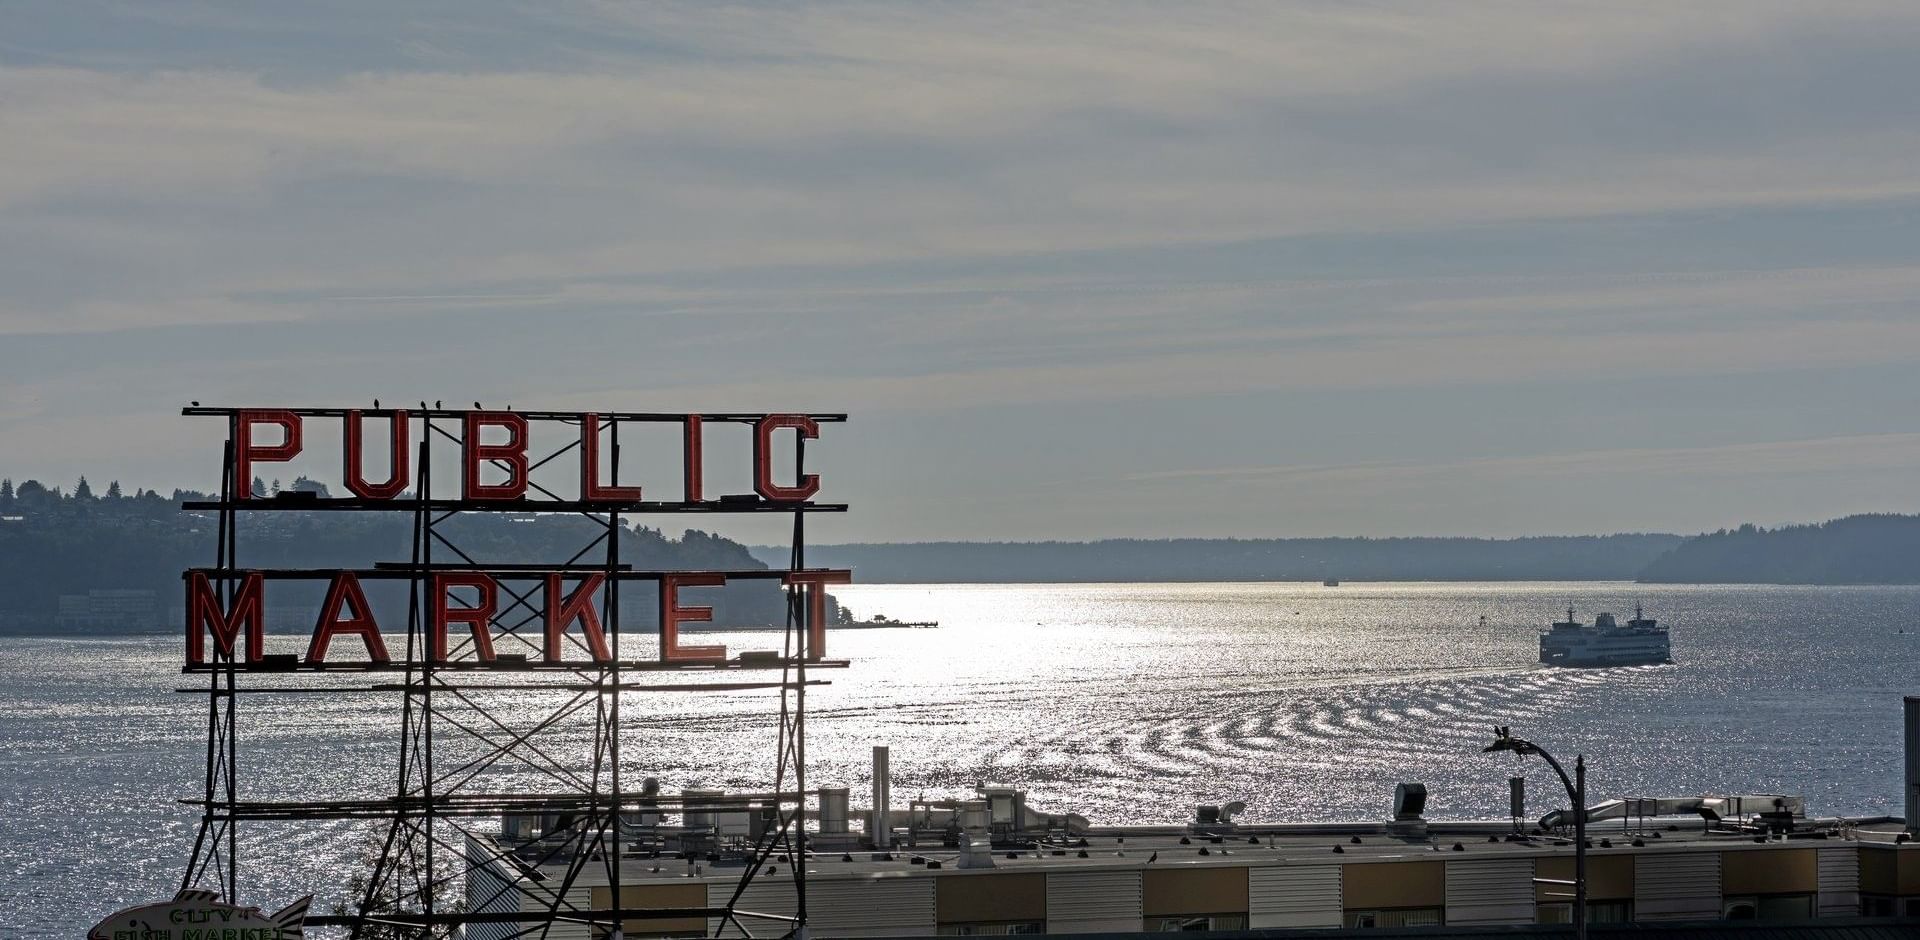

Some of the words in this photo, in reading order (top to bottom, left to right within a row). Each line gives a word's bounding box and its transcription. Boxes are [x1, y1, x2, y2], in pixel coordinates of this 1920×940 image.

[235, 409, 820, 502] PUBLIC
[187, 571, 852, 663] MARKET
[114, 928, 170, 940] FISH
[184, 928, 286, 940] MARKET
[170, 909, 234, 924] CITY
